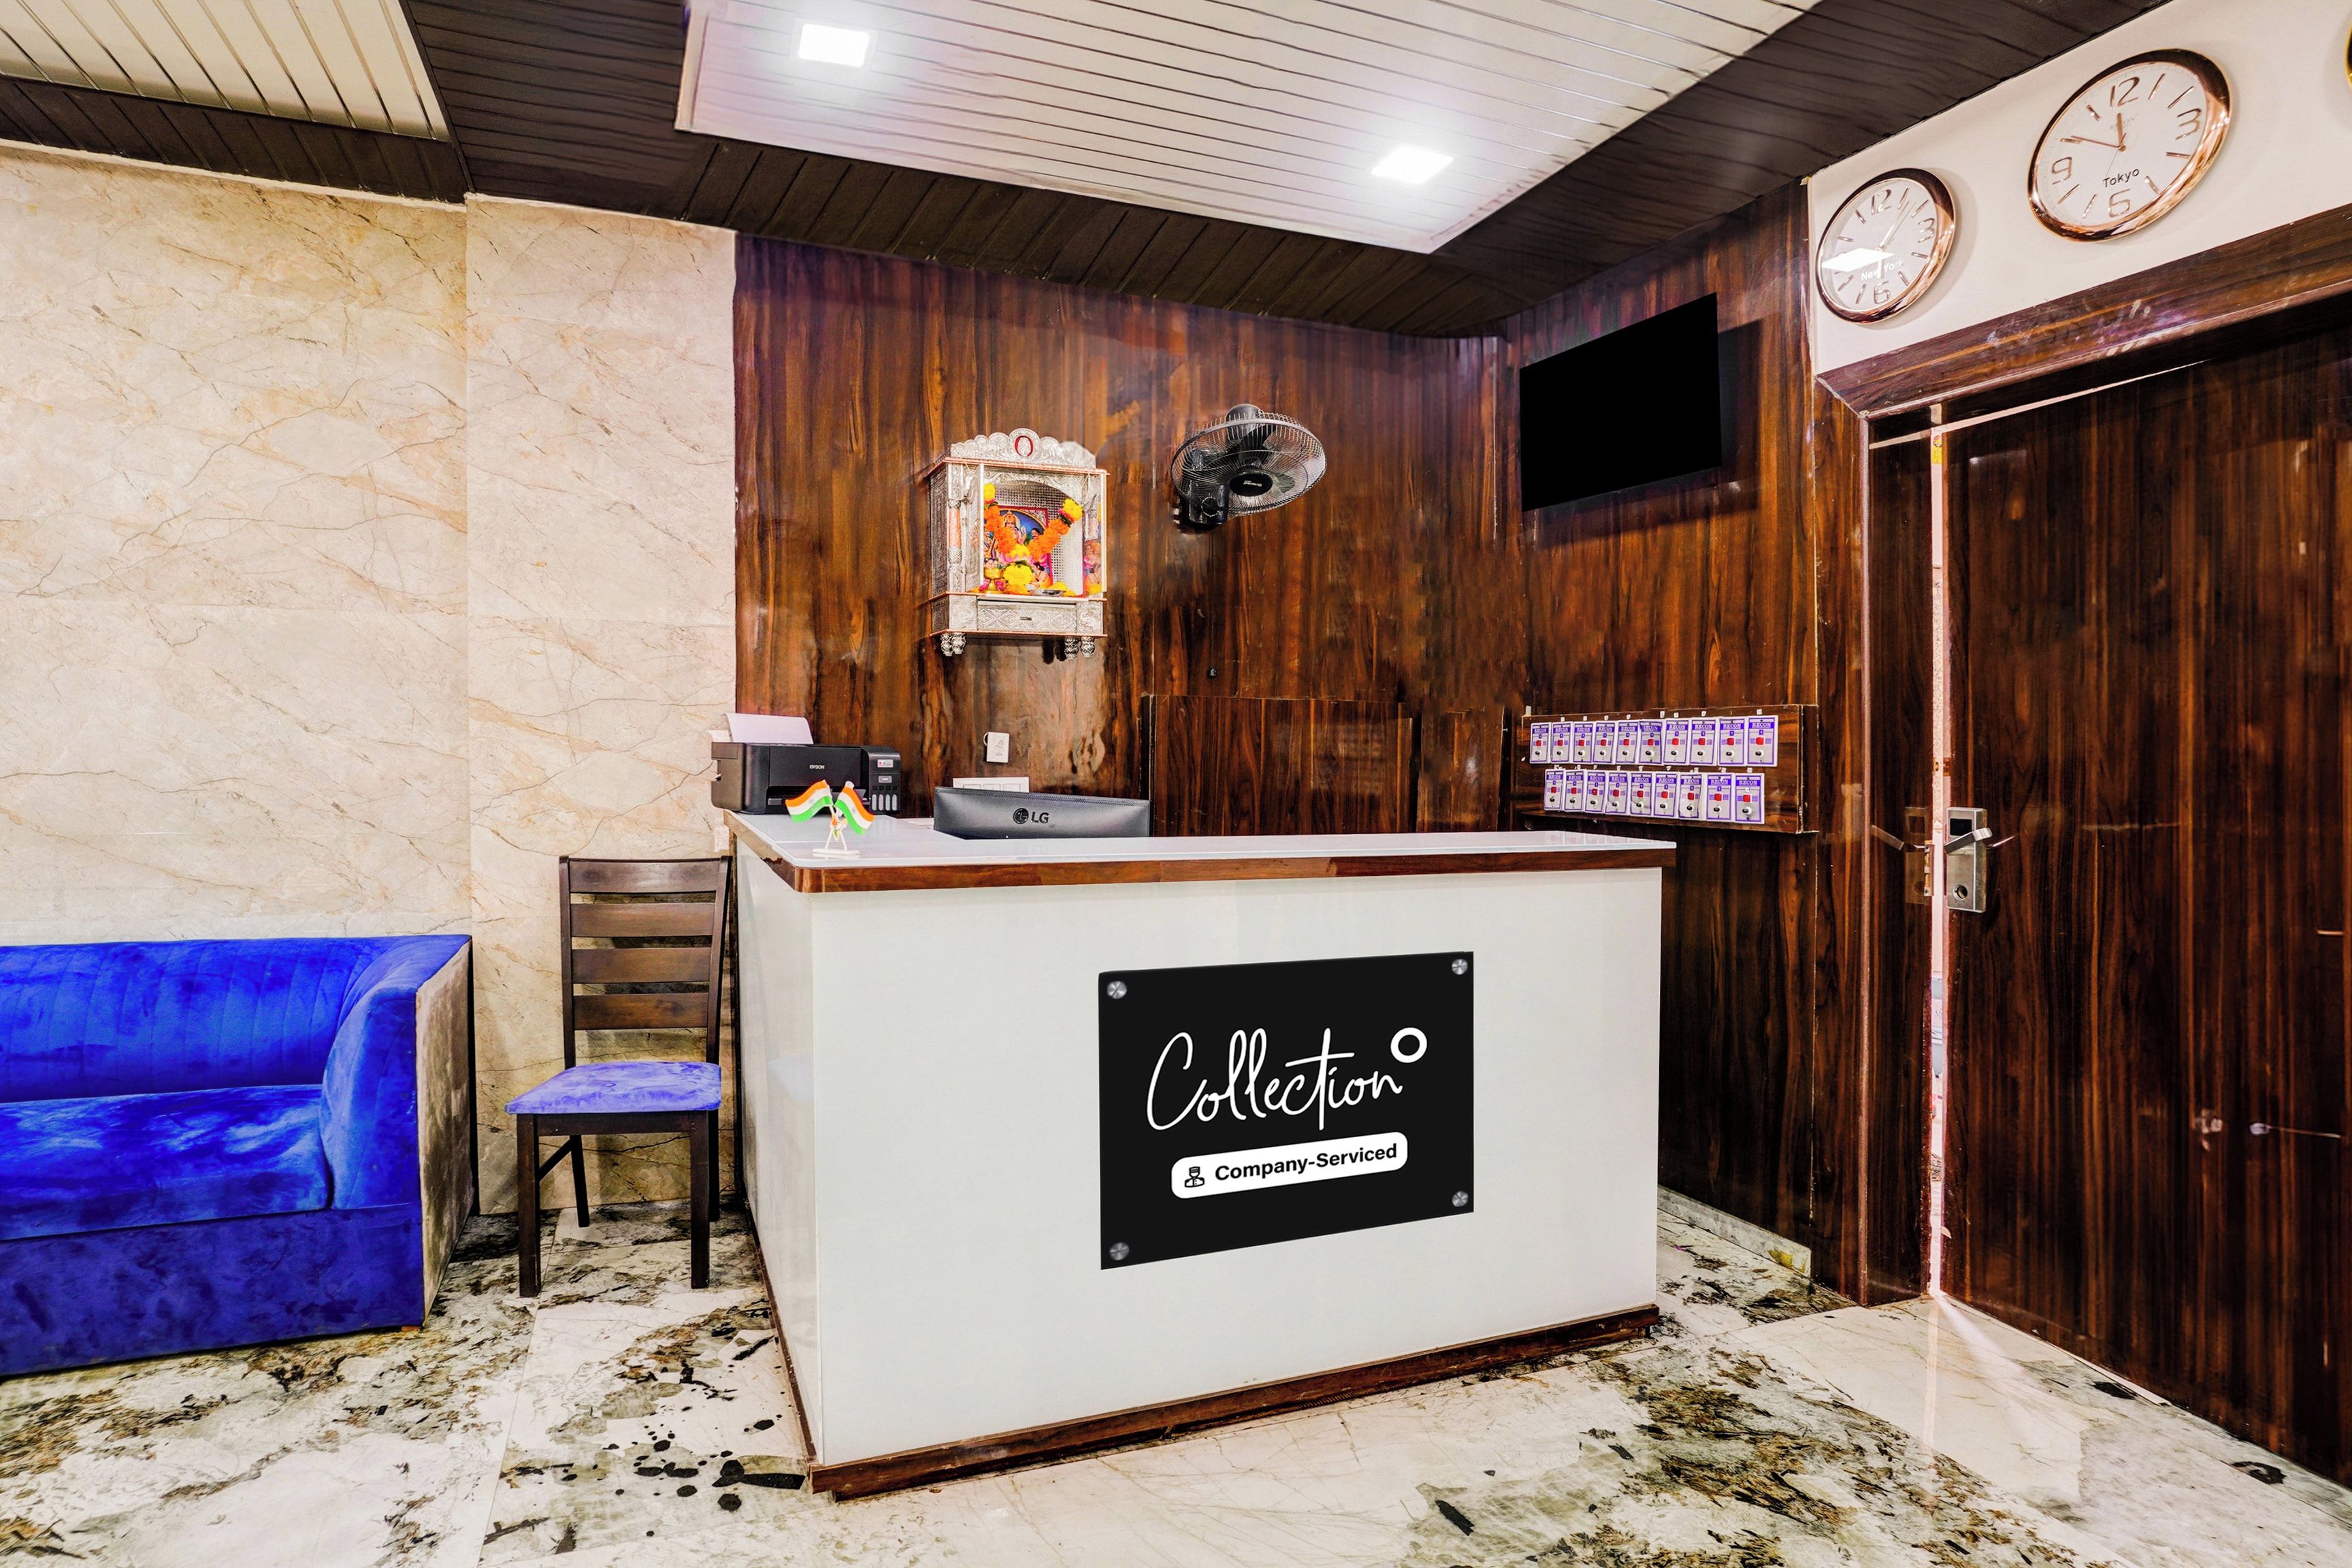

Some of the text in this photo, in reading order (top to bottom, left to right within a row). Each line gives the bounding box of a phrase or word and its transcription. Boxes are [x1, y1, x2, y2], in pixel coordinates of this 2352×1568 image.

[2110, 76, 2140, 110] 12
[2176, 108, 2202, 140] 3
[2051, 157, 2072, 184] 9
[2103, 169, 2140, 188] Tokyo
[1872, 189, 1892, 215] 12
[2108, 189, 2131, 217] 6
[1917, 218, 1935, 243] 3
[1874, 280, 1890, 304] 6
[1031, 812, 1049, 823] LG
[1147, 1028, 1403, 1130] Collection
[1215, 1143, 1397, 1183] Company-Serviced
